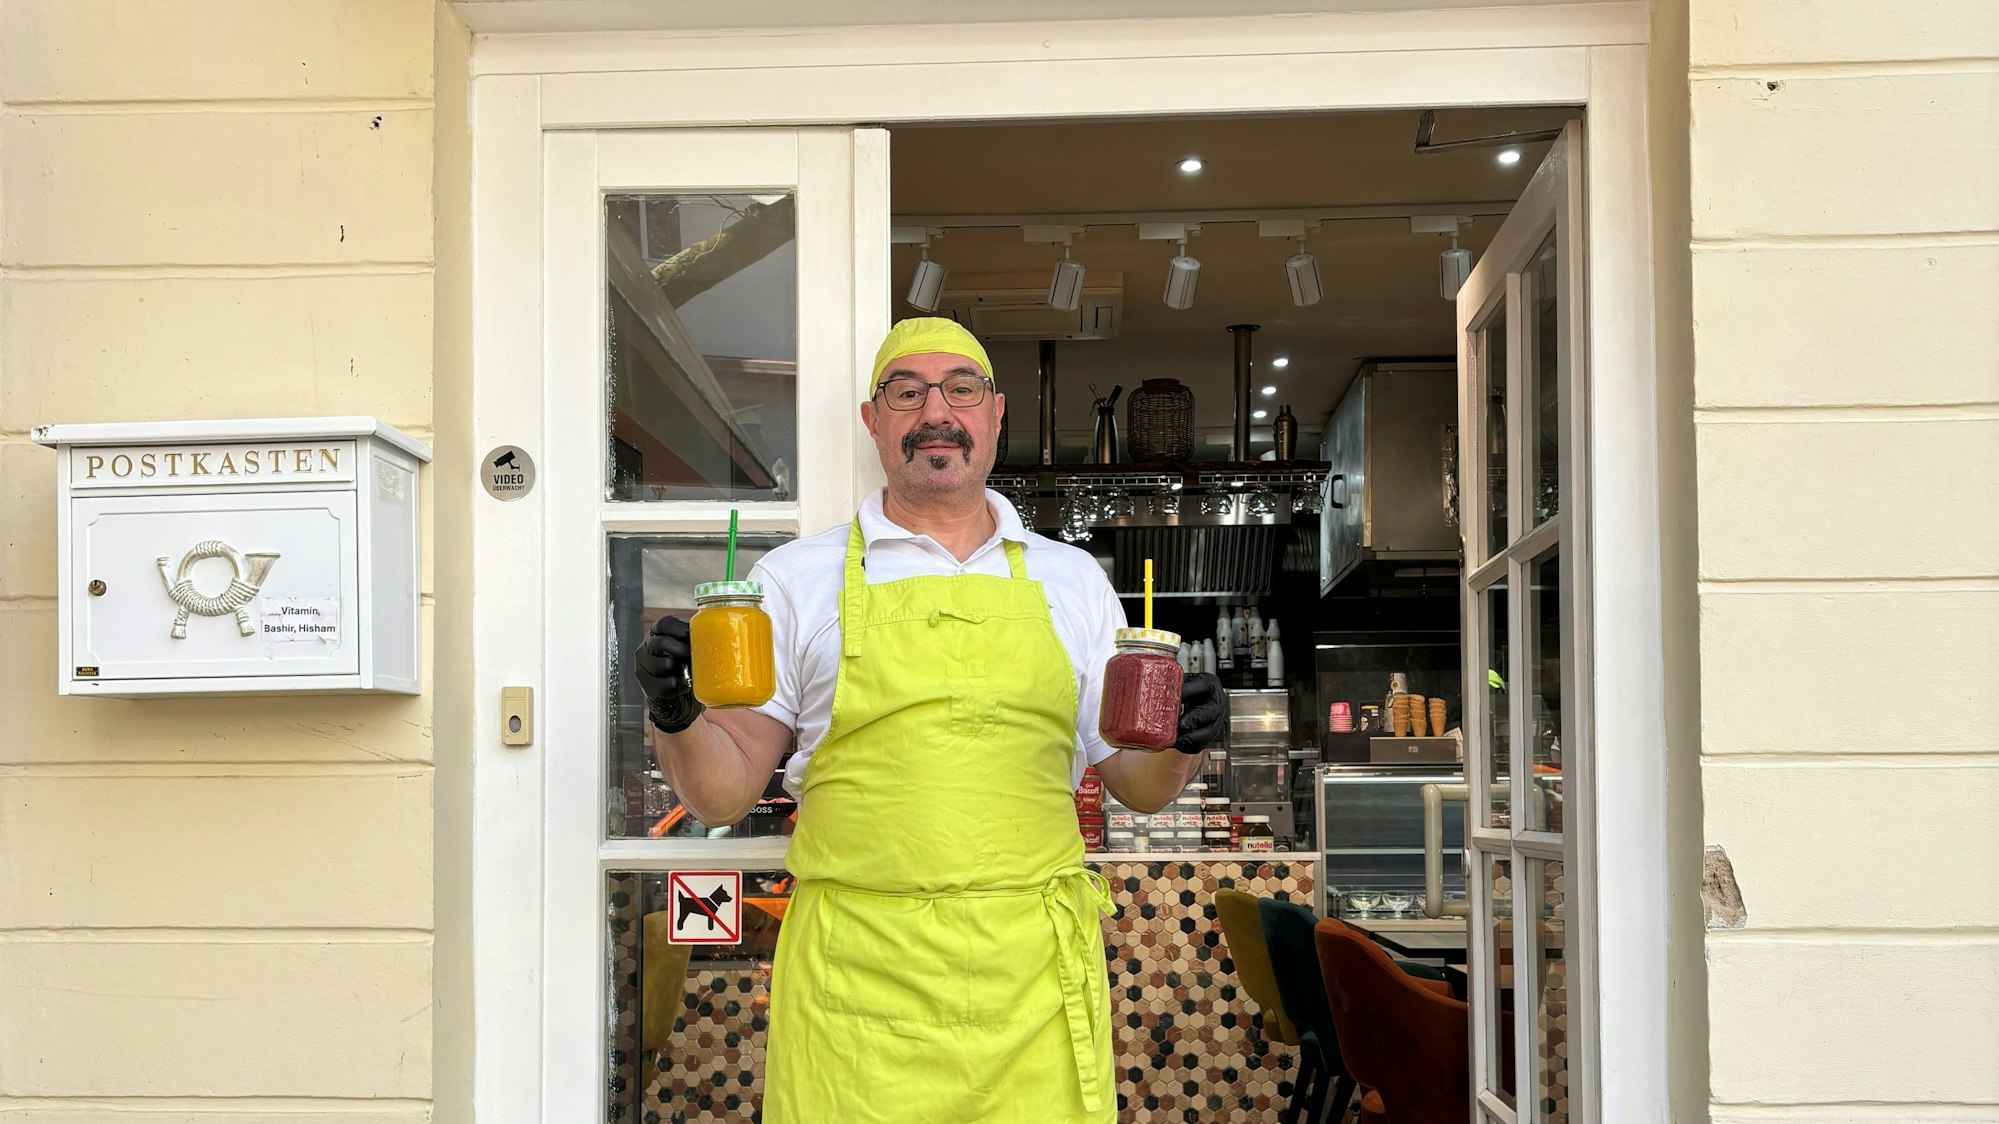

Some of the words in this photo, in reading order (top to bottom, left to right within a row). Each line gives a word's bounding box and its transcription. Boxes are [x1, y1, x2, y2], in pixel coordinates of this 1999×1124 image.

[86, 448, 341, 479] POSTKASTEN
[493, 474, 524, 484] VIDEO
[281, 606, 320, 616] Vitamin,
[264, 624, 296, 634] Bashir,
[298, 624, 336, 633] Hisham
[1247, 841, 1273, 849] nutella
